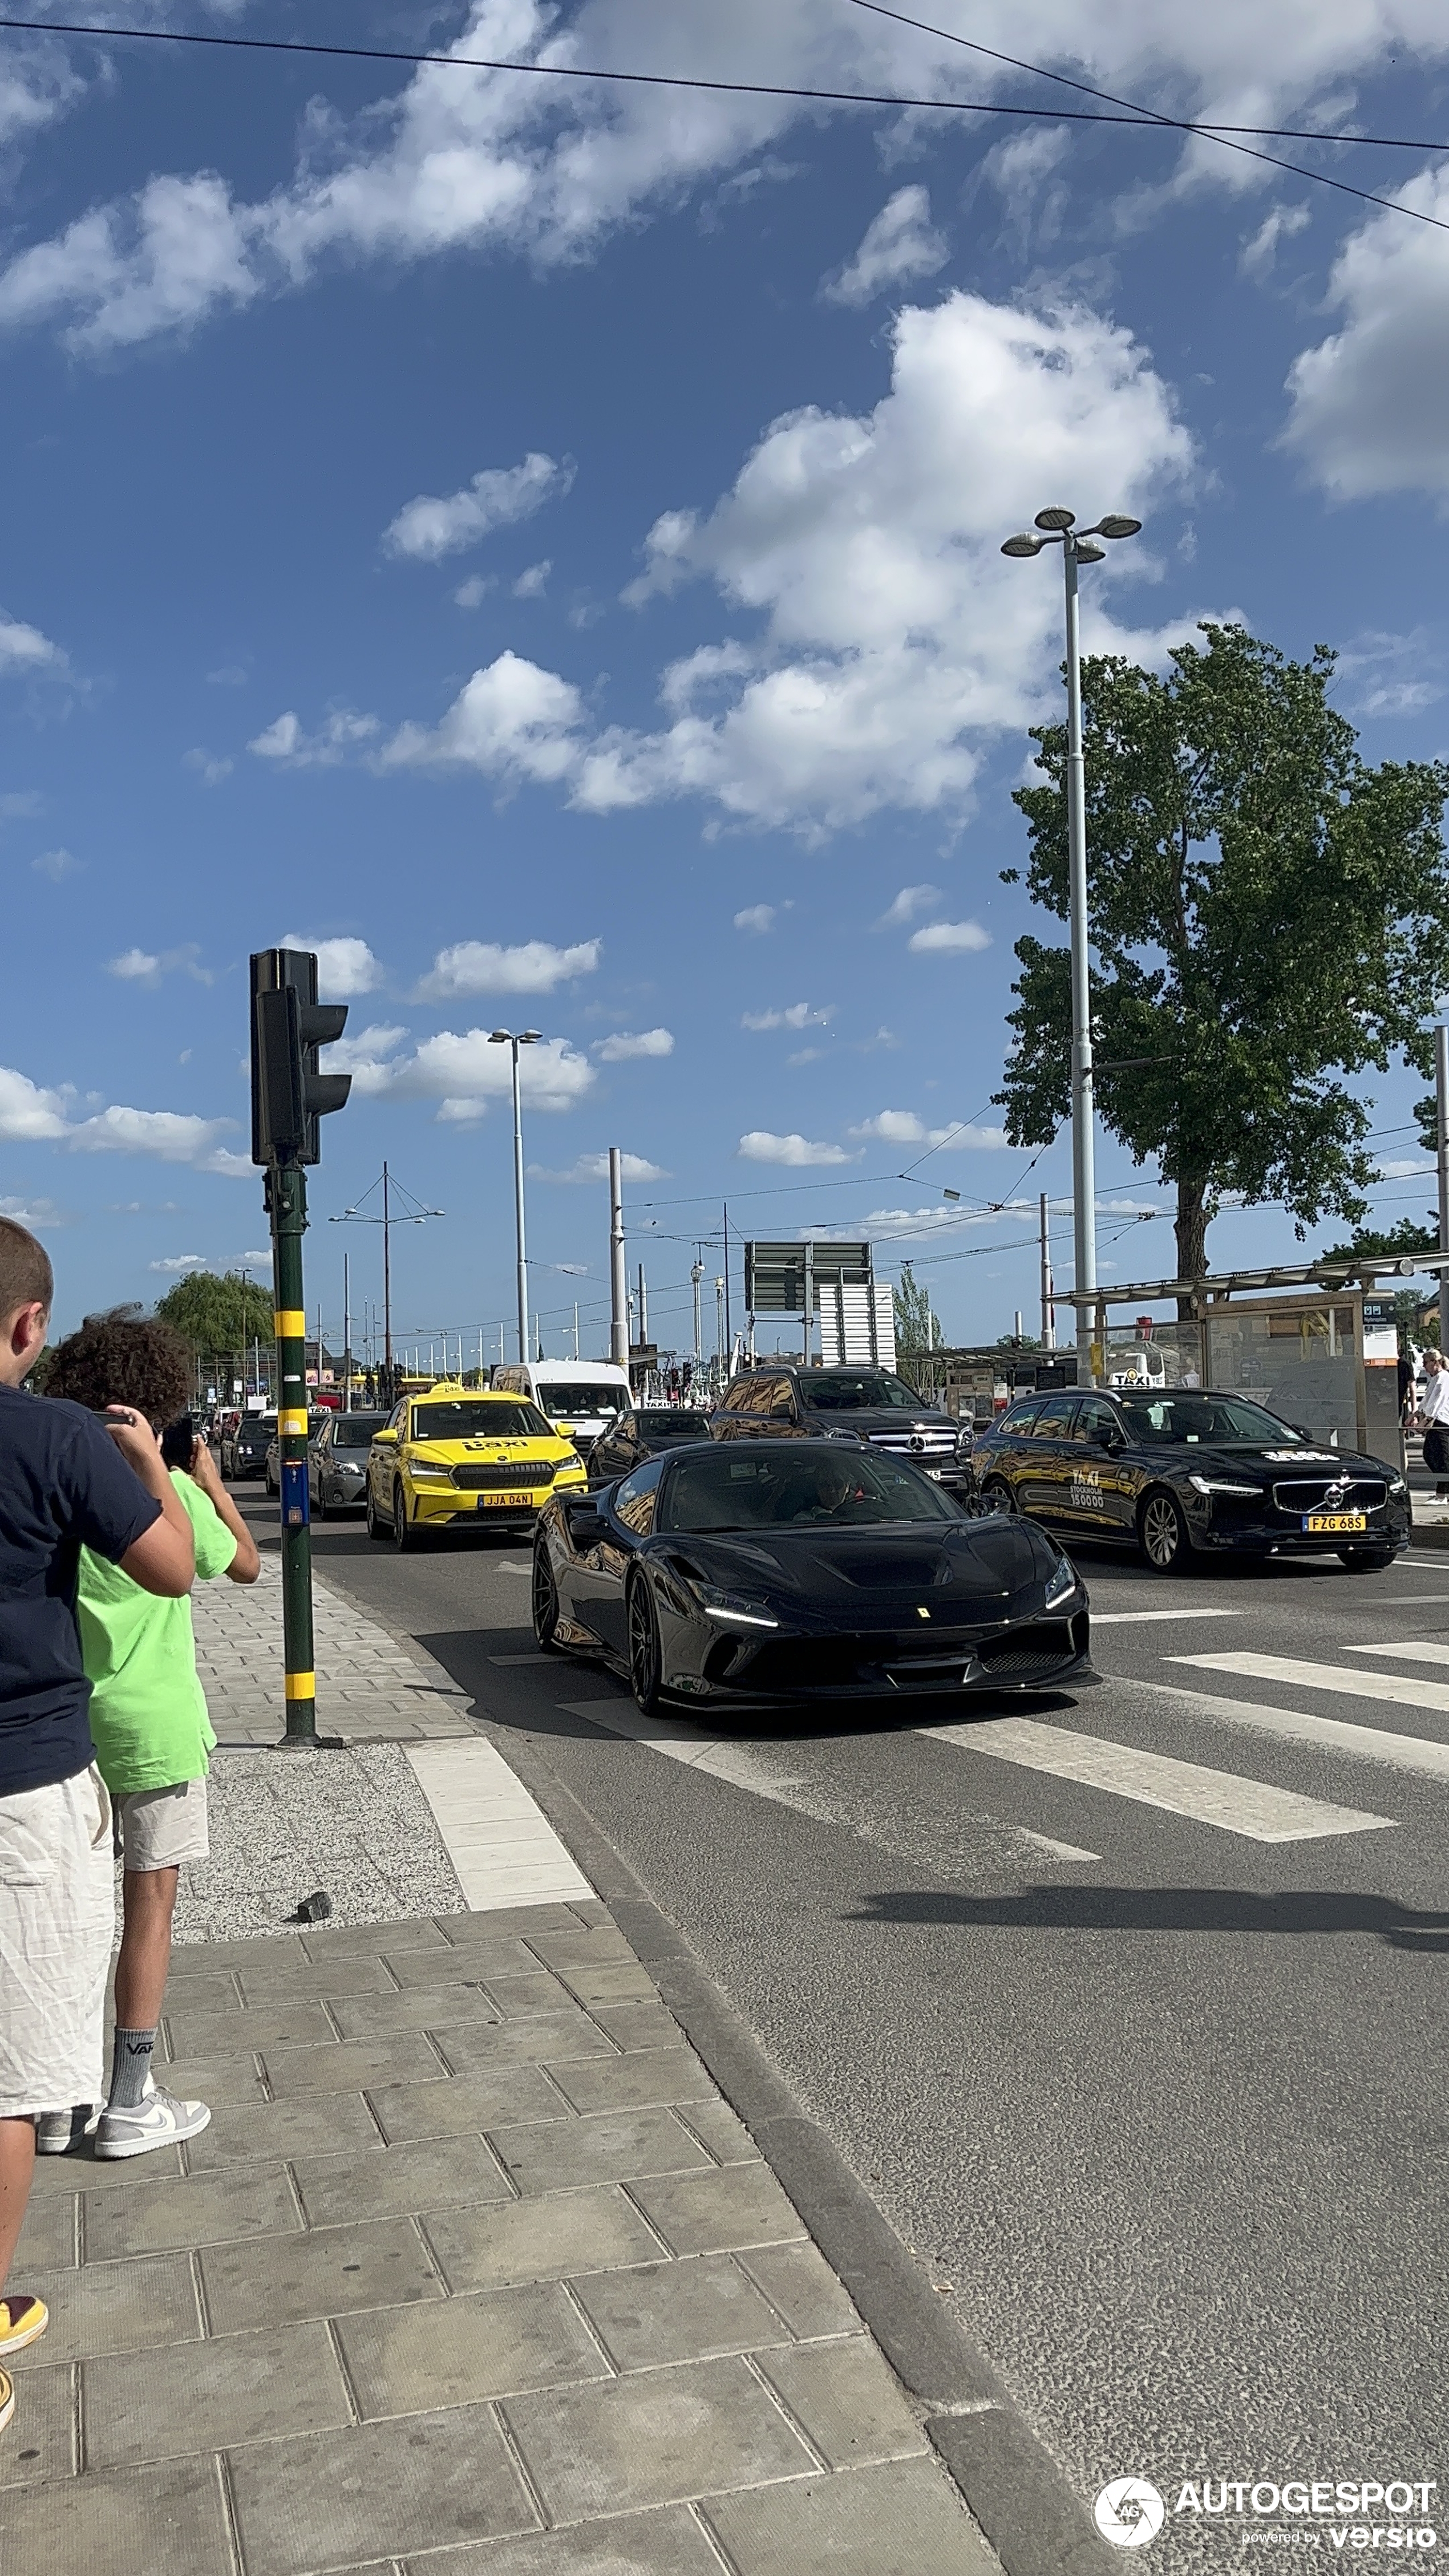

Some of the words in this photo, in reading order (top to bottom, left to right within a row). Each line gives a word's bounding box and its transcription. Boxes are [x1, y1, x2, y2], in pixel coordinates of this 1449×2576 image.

[1115, 1375, 1150, 1386] TAXI
[1073, 1469, 1099, 1487] TAXI
[1070, 1485, 1103, 1495] STOCKHOLM
[487, 1496, 506, 1505] JJA
[509, 1495, 528, 1504] 04N
[1071, 1494, 1104, 1508] 150000
[1313, 1518, 1336, 1529] FZG
[1339, 1517, 1361, 1529] 68S
